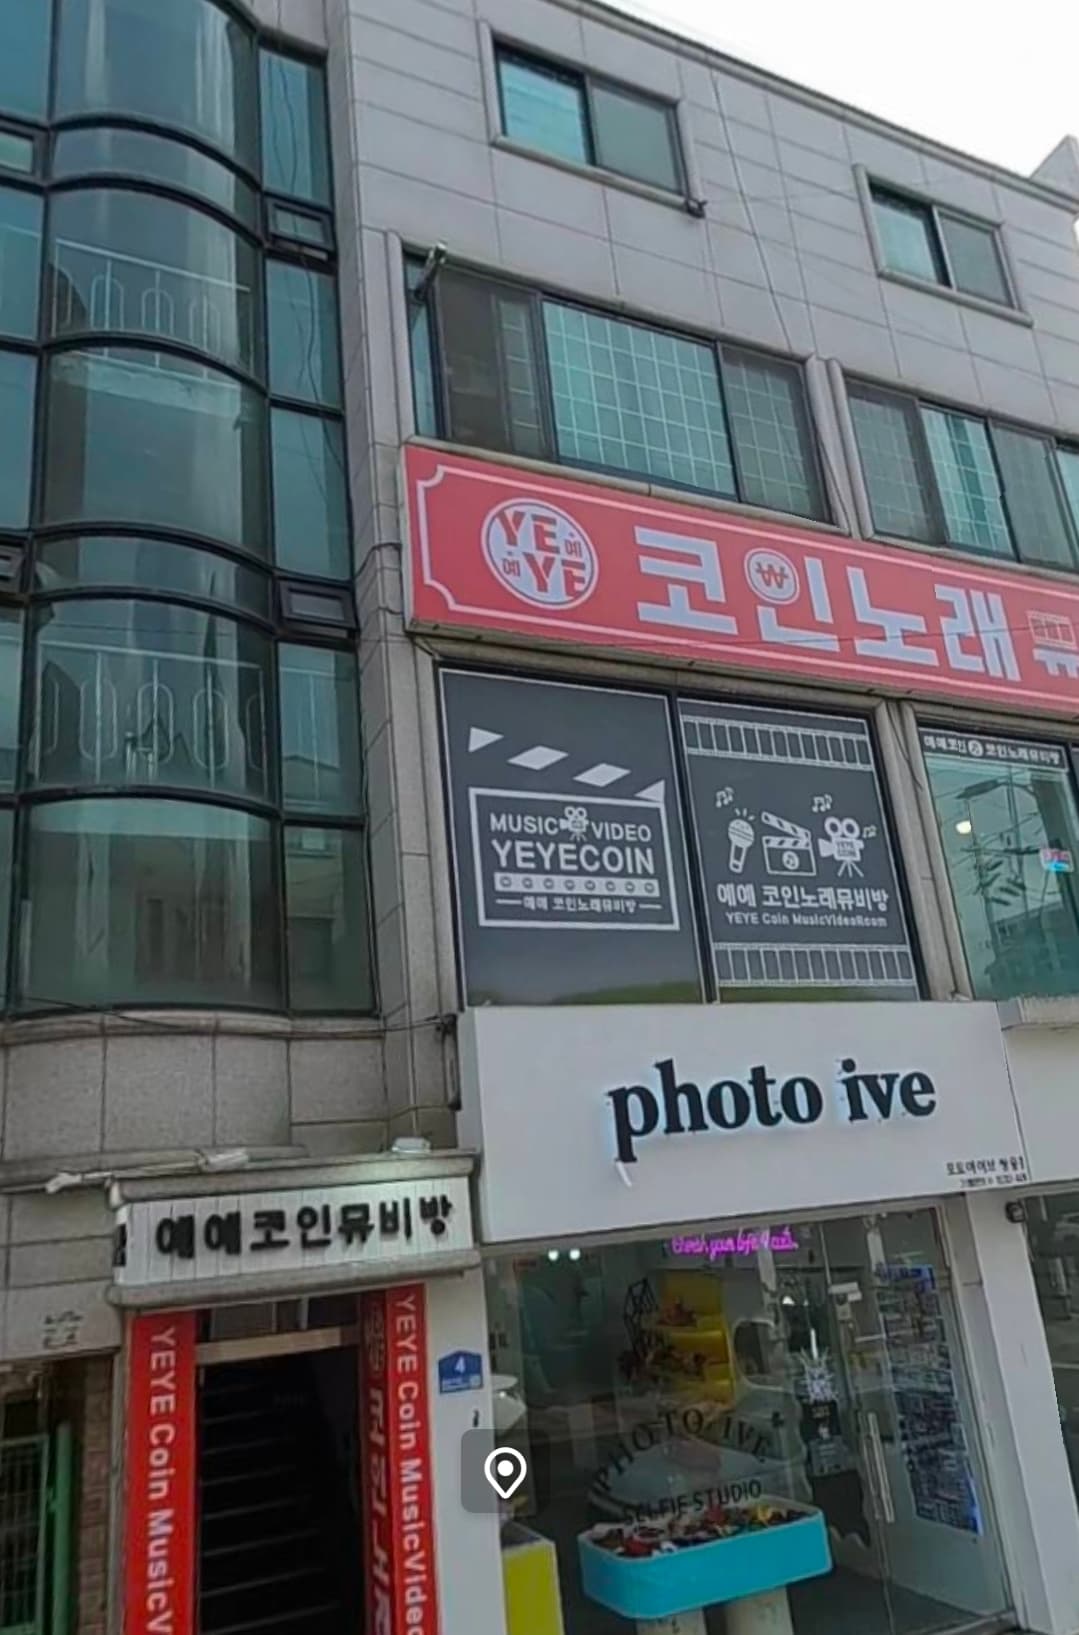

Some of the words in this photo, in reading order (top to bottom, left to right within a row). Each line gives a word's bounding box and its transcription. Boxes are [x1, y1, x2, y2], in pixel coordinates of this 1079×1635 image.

[490, 813, 559, 836] MUSIC
[591, 823, 652, 843] VIDEO
[492, 839, 655, 875] YEYECOIN
[717, 883, 756, 907] 예예
[762, 884, 889, 912] 코인노래뮤비방
[725, 912, 760, 925] YEYE
[762, 913, 790, 925] Coin
[606, 1058, 823, 1163] photo
[841, 1058, 937, 1122] ive
[155, 1194, 453, 1259] 예예코인뮤비방
[395, 1293, 418, 1373] YEYE
[151, 1326, 176, 1416] YEYE
[398, 1381, 421, 1450] Coin
[149, 1423, 176, 1500] Coin
[692, 1479, 762, 1511] STUDIO
